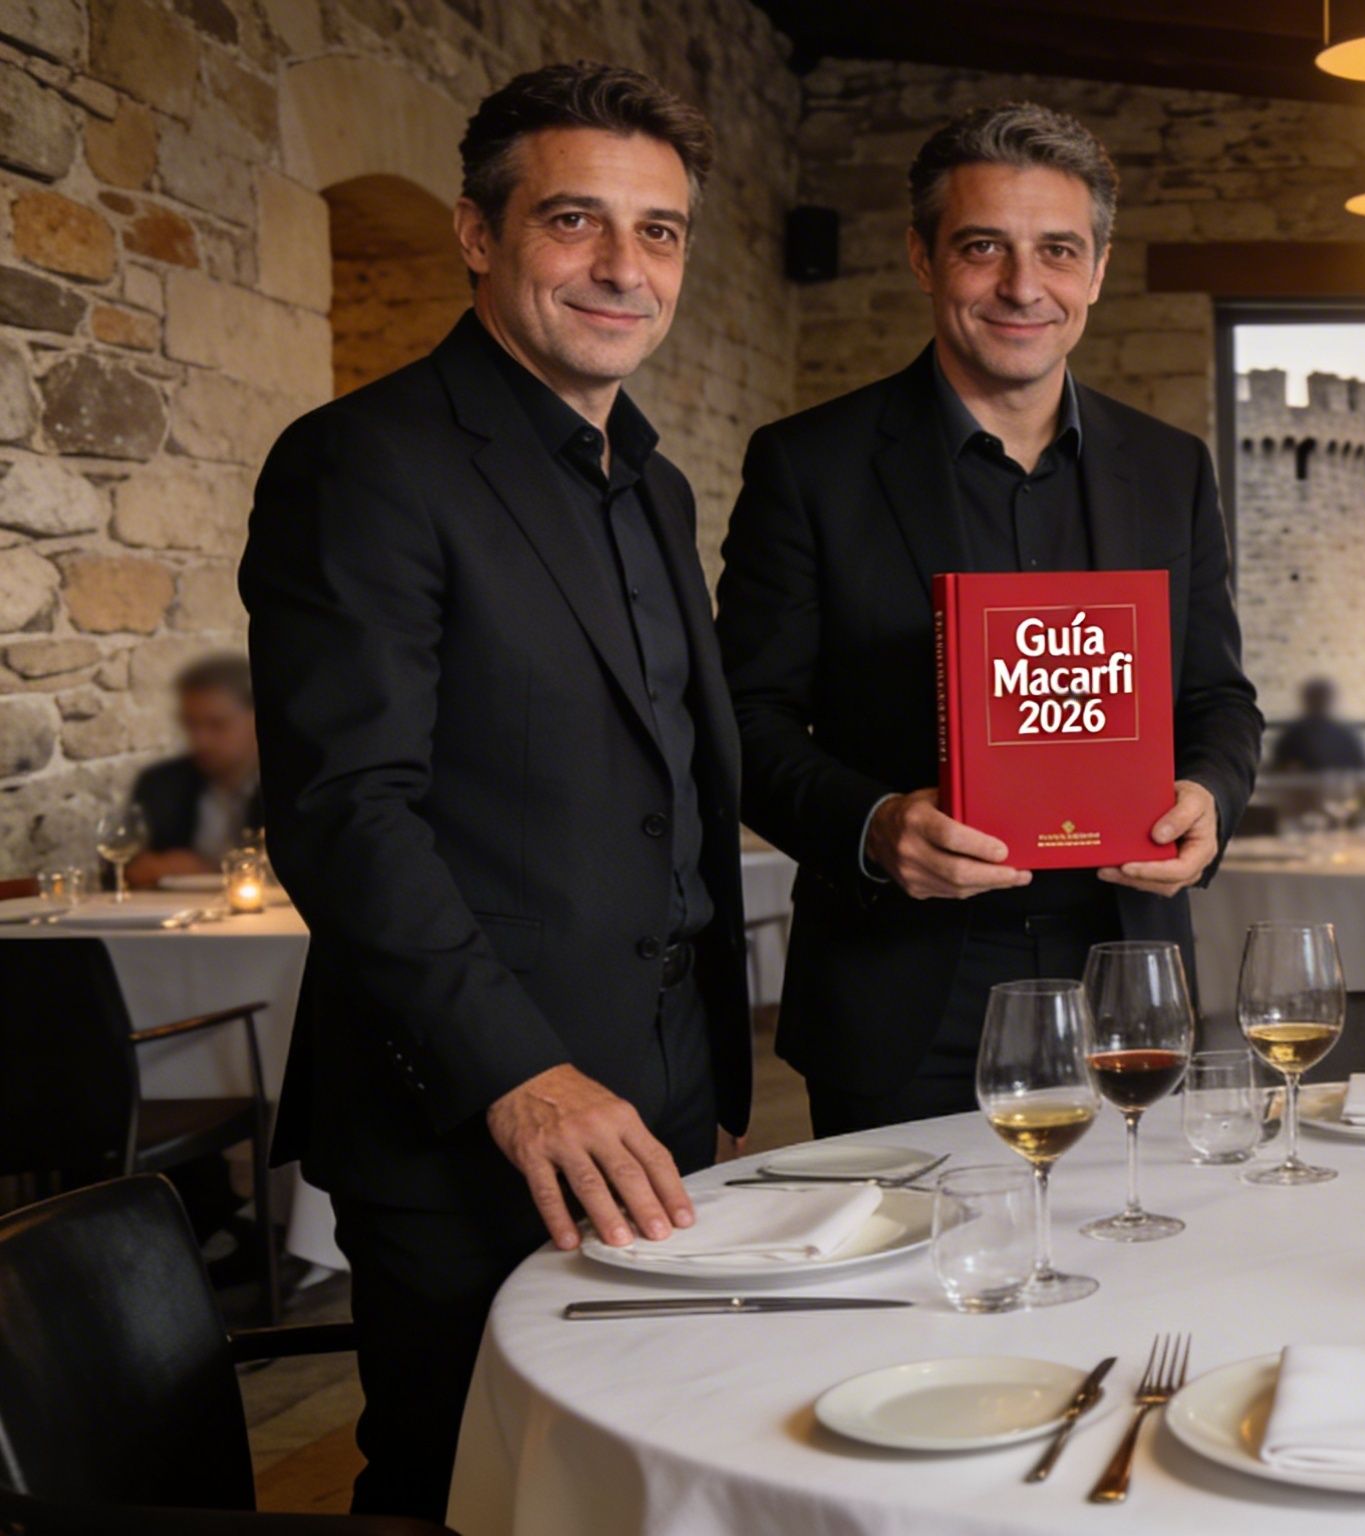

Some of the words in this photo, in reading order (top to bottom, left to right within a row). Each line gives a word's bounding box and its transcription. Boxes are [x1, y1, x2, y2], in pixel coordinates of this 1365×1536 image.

[1016, 612, 1105, 656] Guía
[993, 652, 1133, 697] Macarfi
[1018, 699, 1106, 734] 2026
